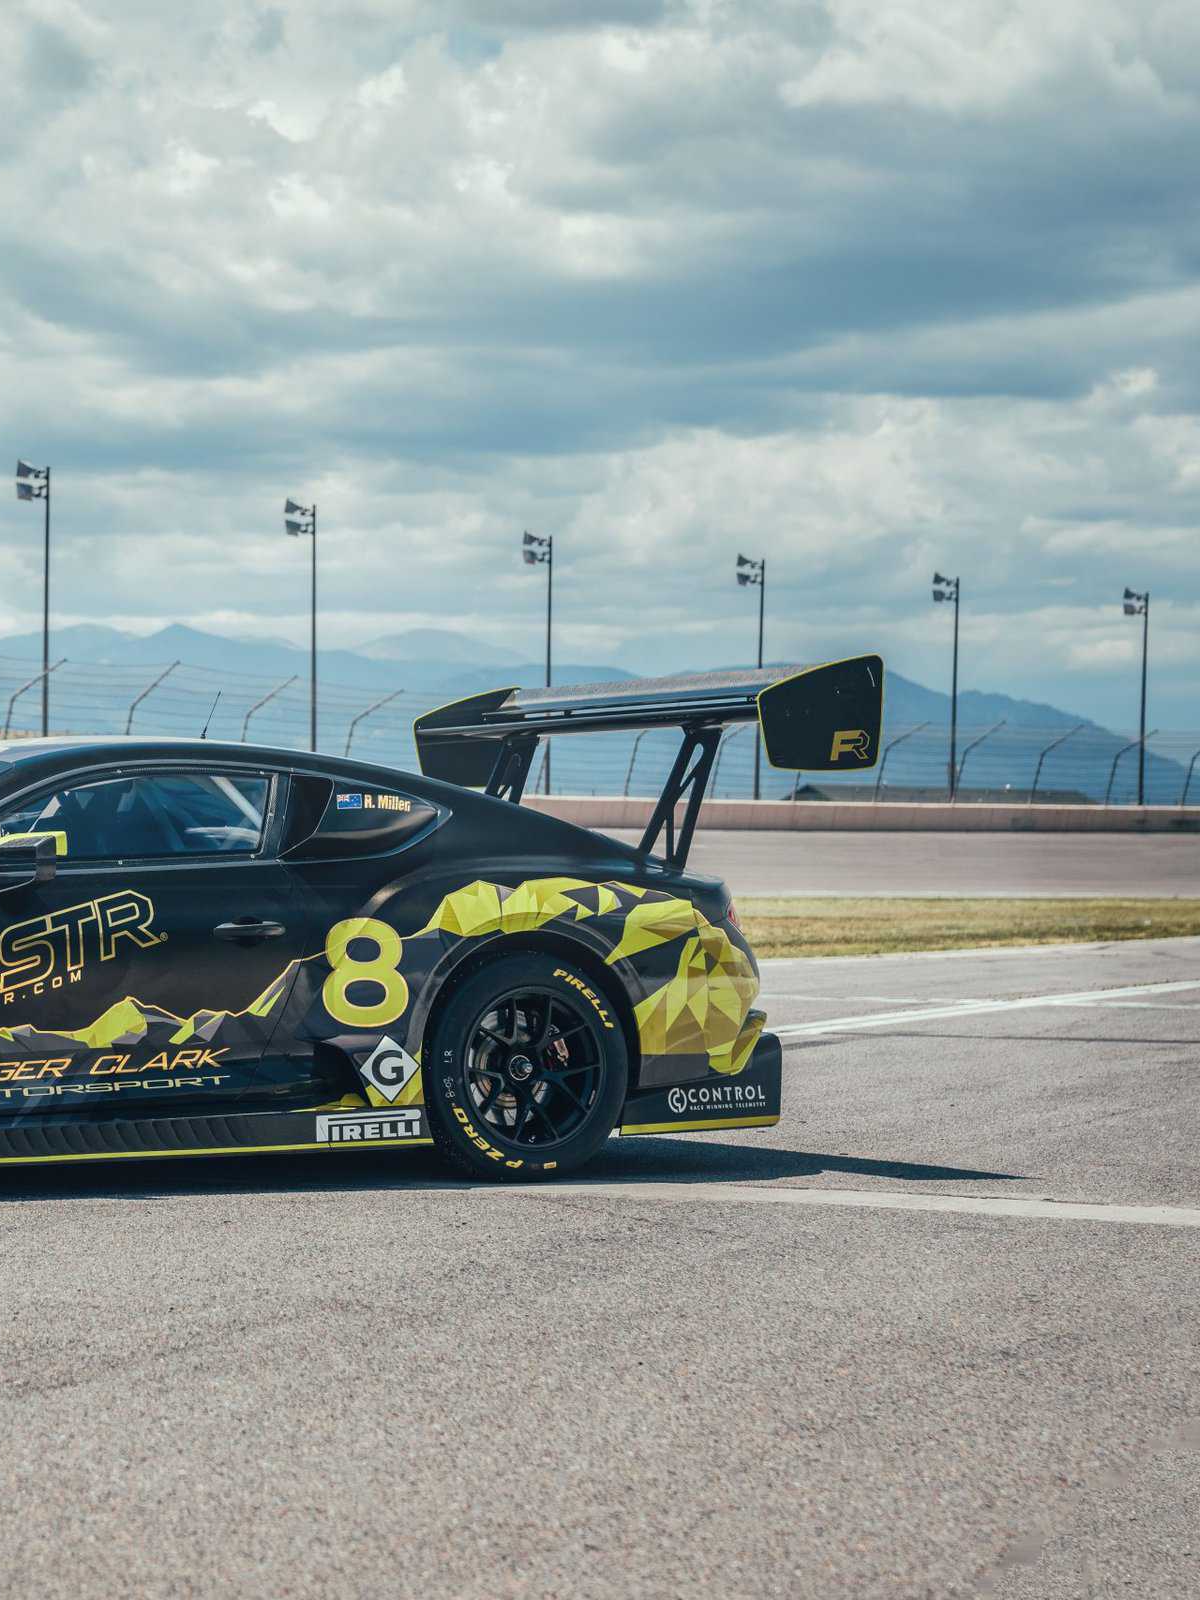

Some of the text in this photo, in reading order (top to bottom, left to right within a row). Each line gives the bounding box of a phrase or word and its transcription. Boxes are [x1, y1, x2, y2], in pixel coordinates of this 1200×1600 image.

[364, 794, 376, 809] R.
[322, 916, 409, 1028] 8
[552, 968, 615, 1029] PIRELLI
[88, 1046, 231, 1076] CLARK
[371, 1049, 405, 1087] G
[687, 1085, 766, 1104] CONTROL
[315, 1109, 422, 1143] PIRELLI
[453, 1107, 505, 1161] ZERO
